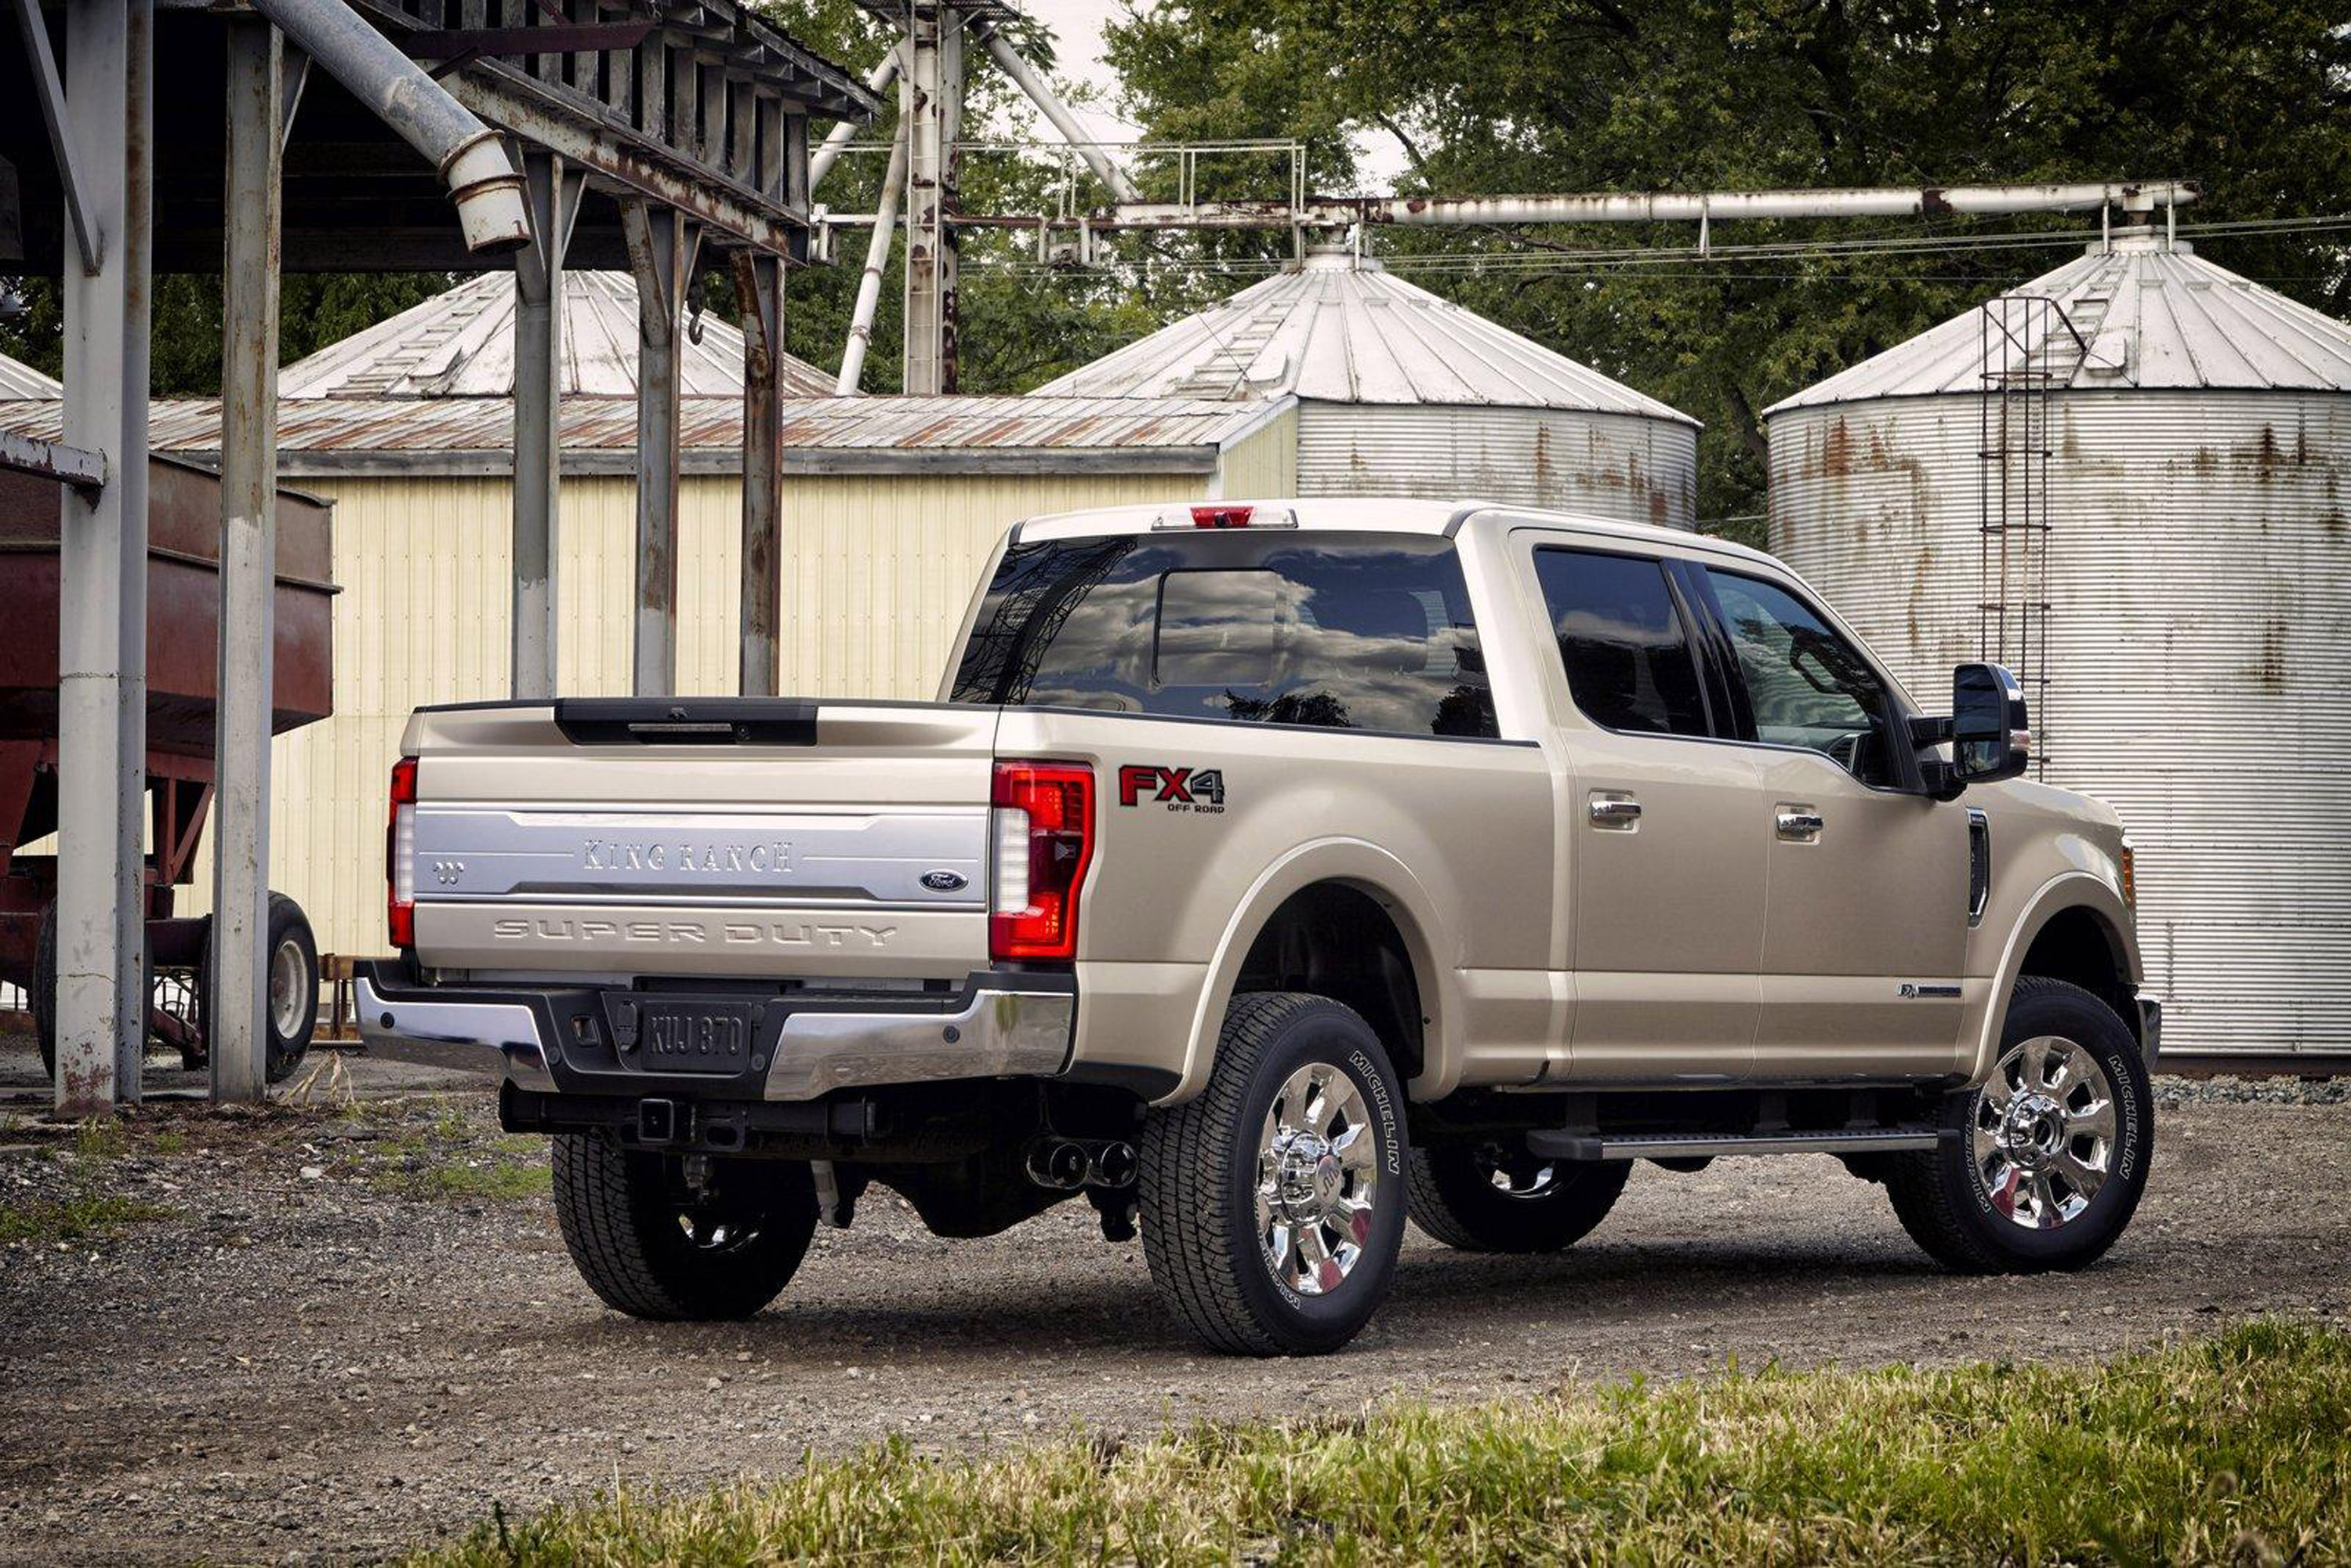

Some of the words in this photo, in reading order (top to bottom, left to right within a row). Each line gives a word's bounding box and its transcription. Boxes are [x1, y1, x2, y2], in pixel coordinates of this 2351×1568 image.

[1119, 764, 1224, 807] FX4
[1194, 804, 1224, 813] ROAD
[582, 840, 665, 872] KING
[680, 843, 793, 872] RANCH
[494, 920, 706, 942] SUPER
[725, 924, 897, 946] DUTY
[1349, 1051, 1399, 1174] MICHELIN
[2108, 1055, 2138, 1180] MICHELIN
